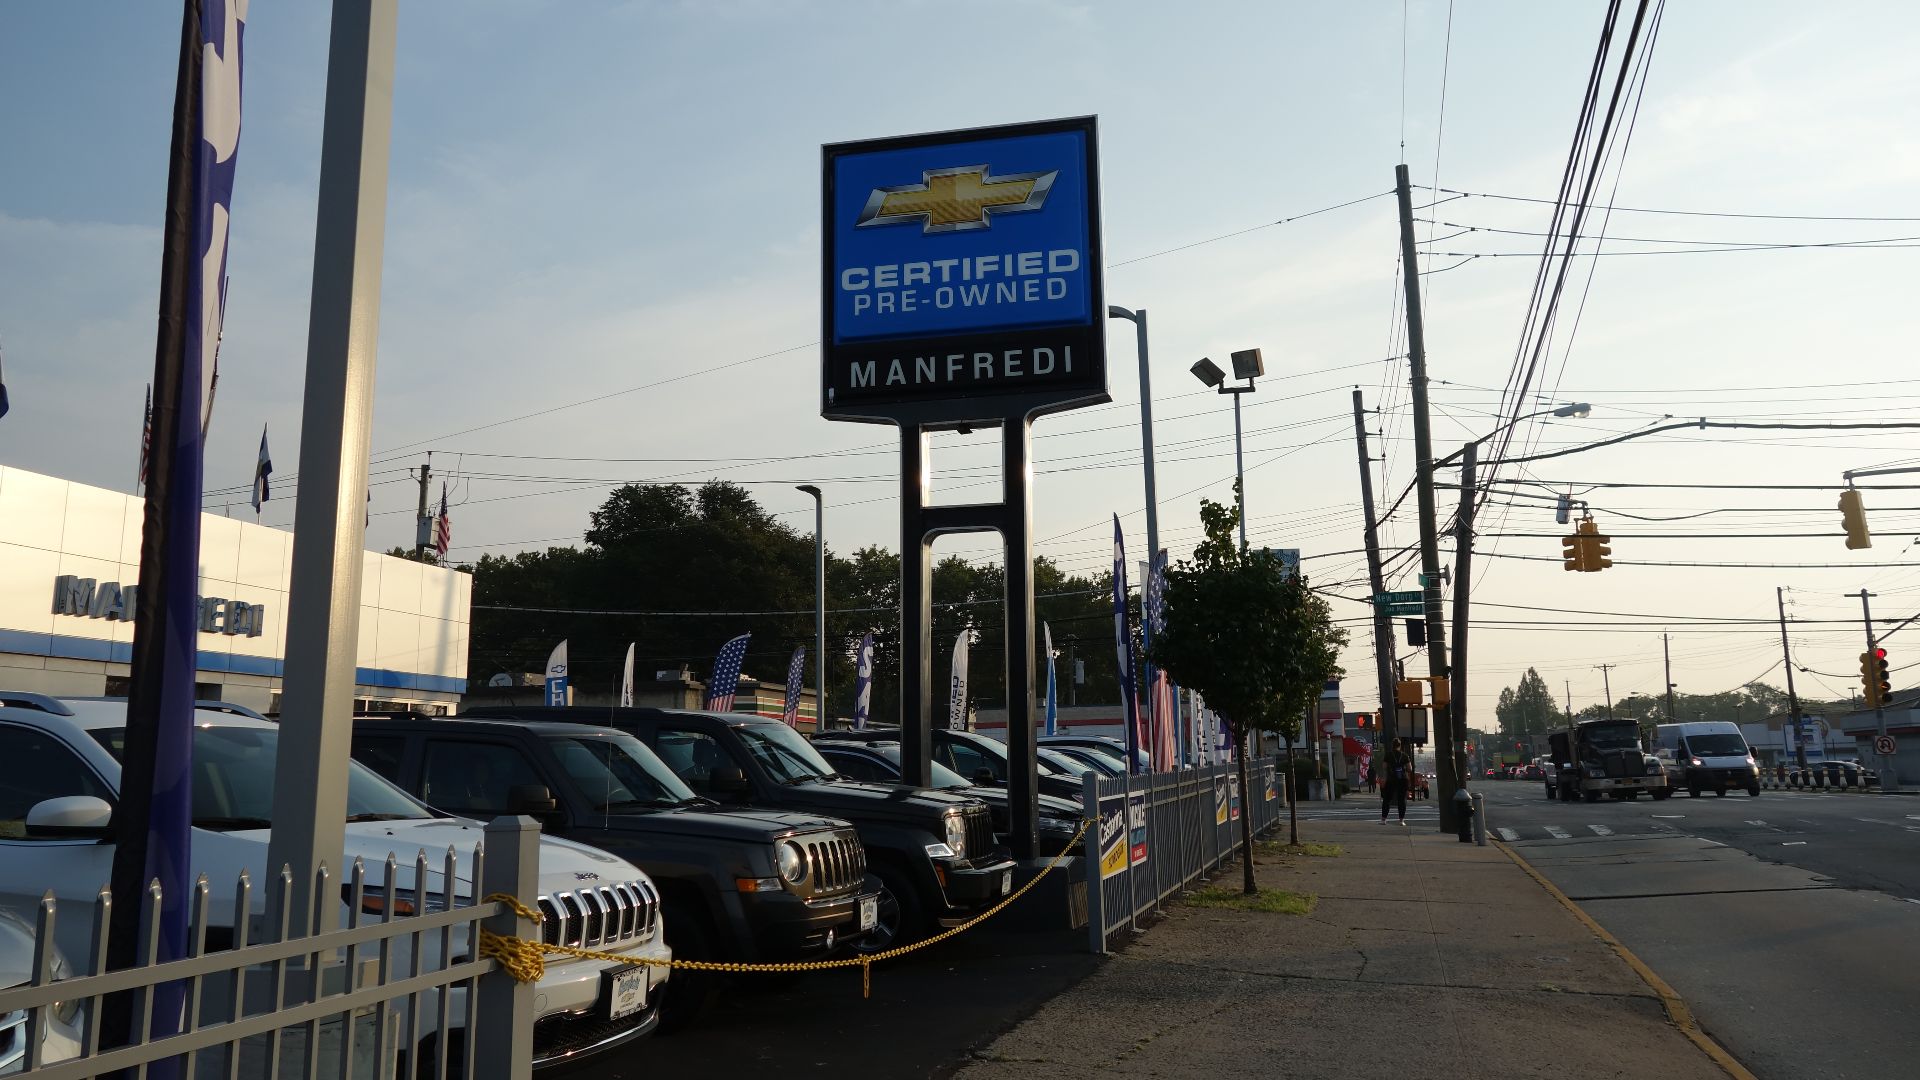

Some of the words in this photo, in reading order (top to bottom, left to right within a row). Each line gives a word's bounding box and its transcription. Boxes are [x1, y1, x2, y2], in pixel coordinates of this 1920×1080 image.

[841, 248, 1080, 291] CERTIFIED
[854, 277, 1067, 317] PRE-OWNED
[850, 345, 1073, 388] MANFREDI
[51, 575, 265, 637] MAEDI
[1375, 595, 1392, 603] New
[953, 680, 965, 729] OWNED
